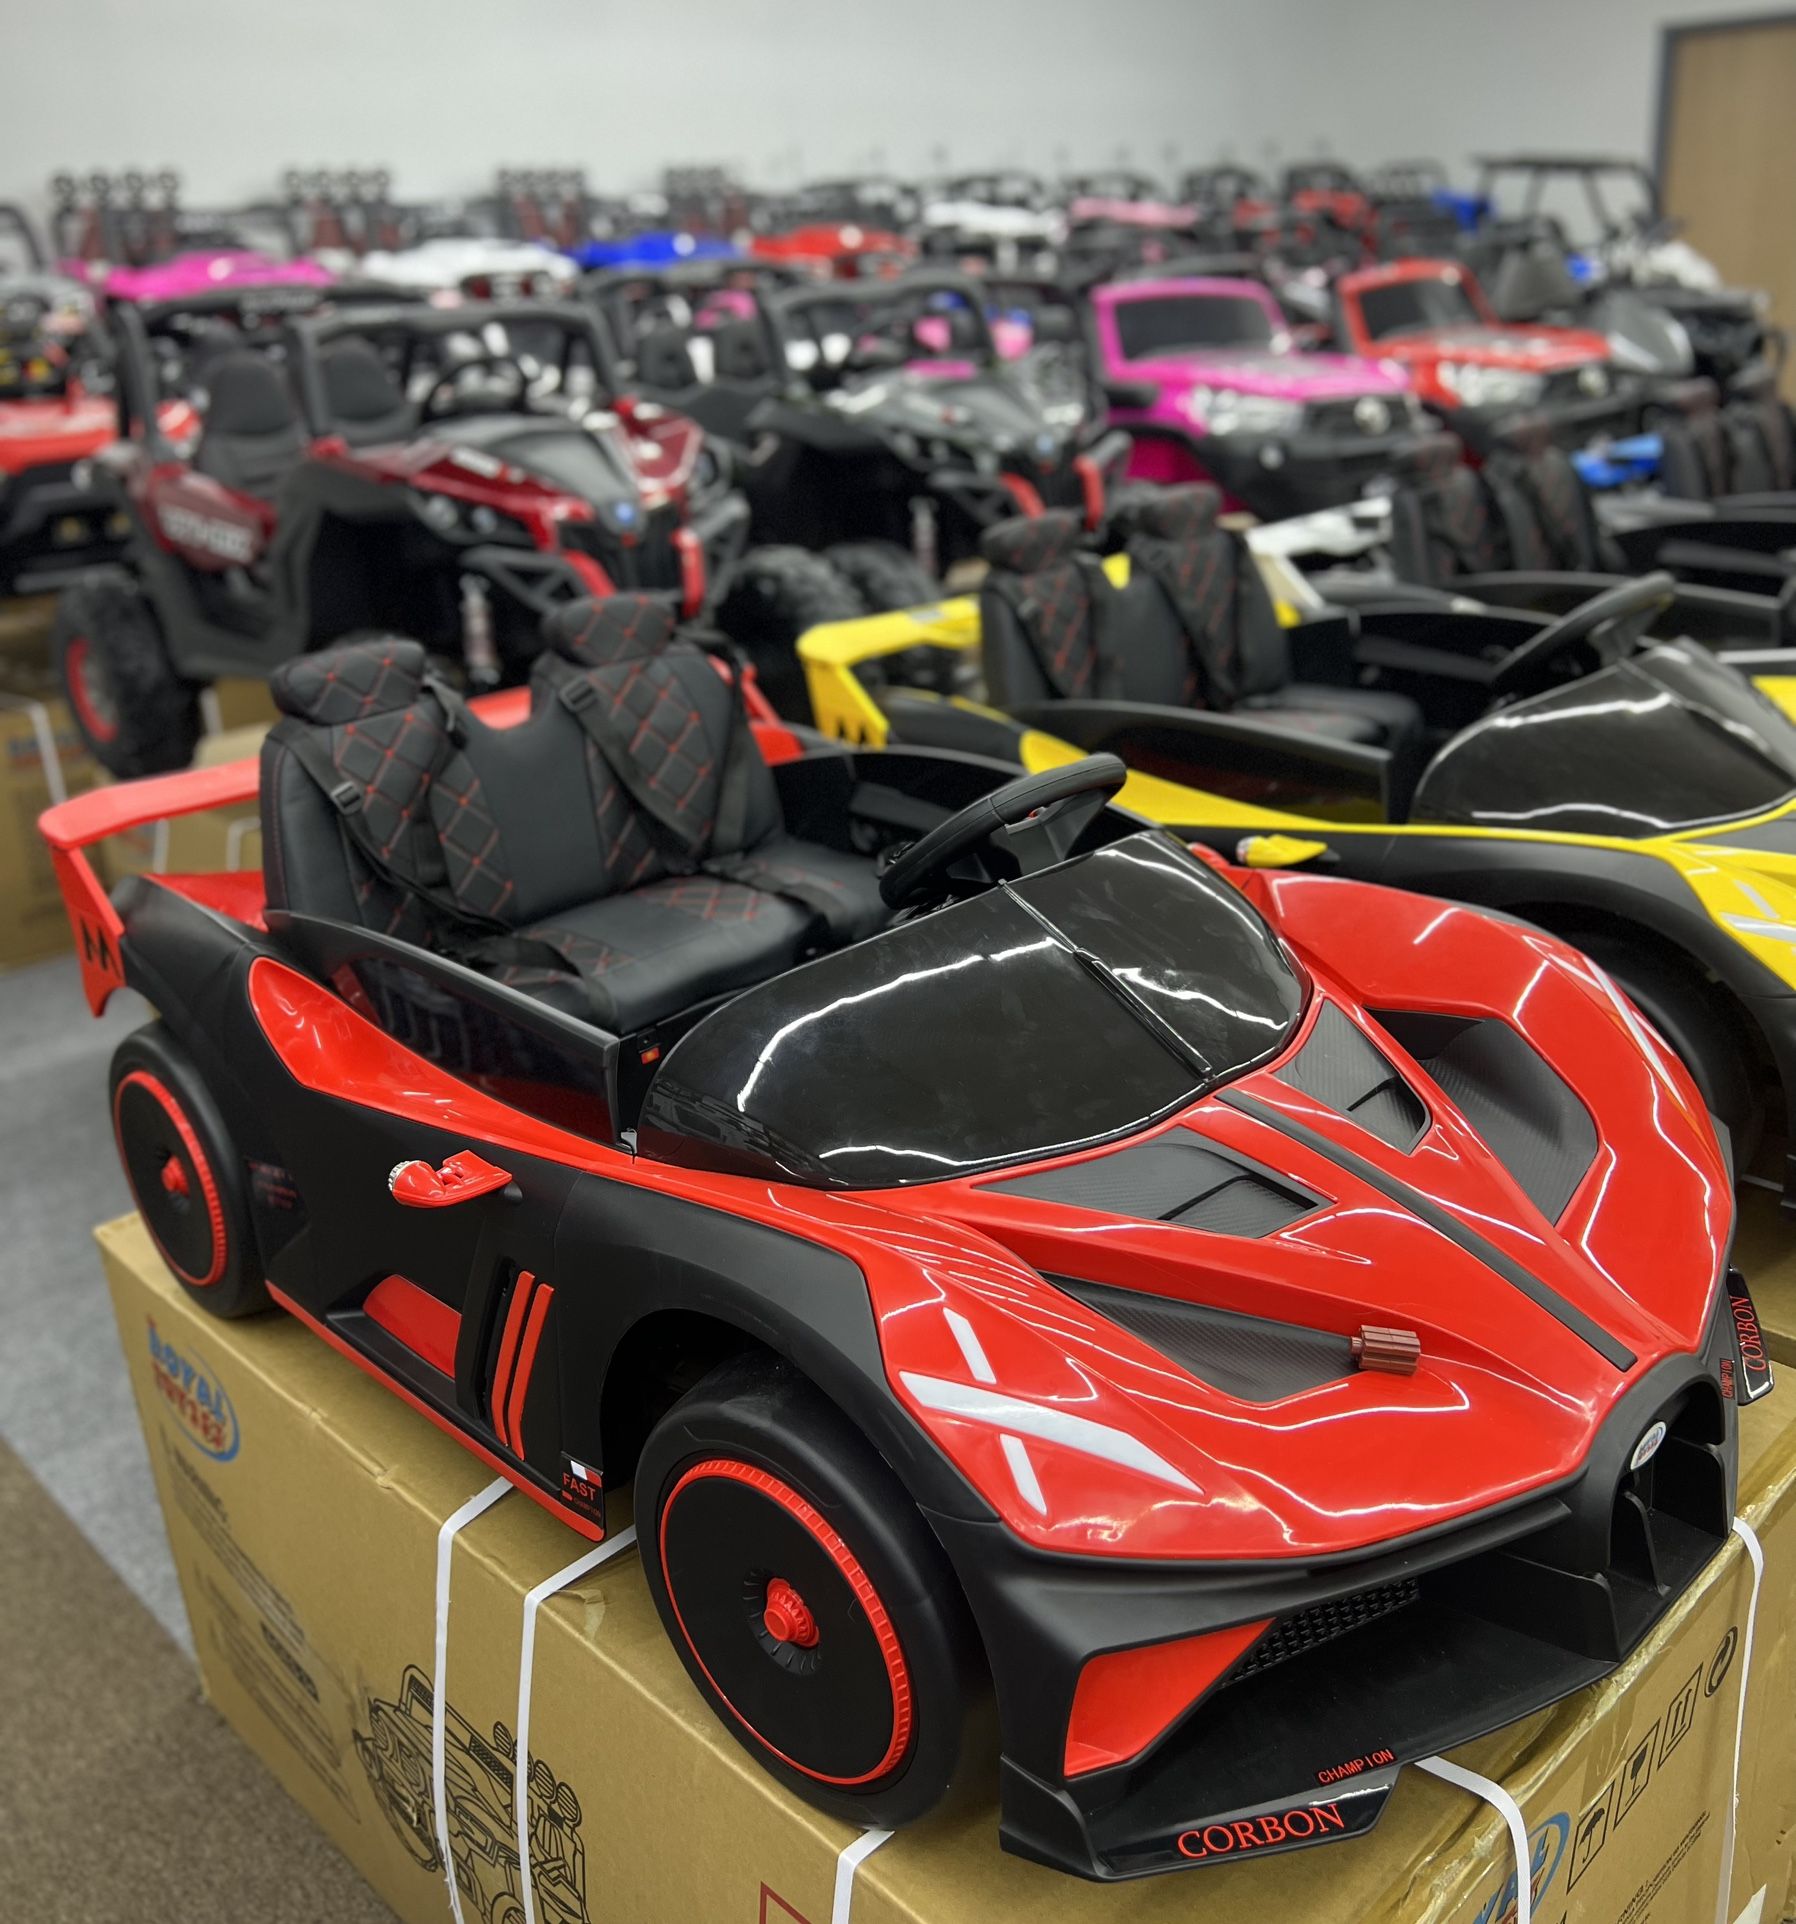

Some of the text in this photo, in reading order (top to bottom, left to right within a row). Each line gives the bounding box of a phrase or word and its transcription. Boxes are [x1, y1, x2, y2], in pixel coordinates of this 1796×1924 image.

[1730, 1296, 1767, 1372] CORBON
[1721, 1359, 1734, 1399] CHAMPION
[563, 1472, 596, 1501] FAST
[1317, 1749, 1394, 1784] CHAMPION
[1177, 1803, 1345, 1859] CORBON
